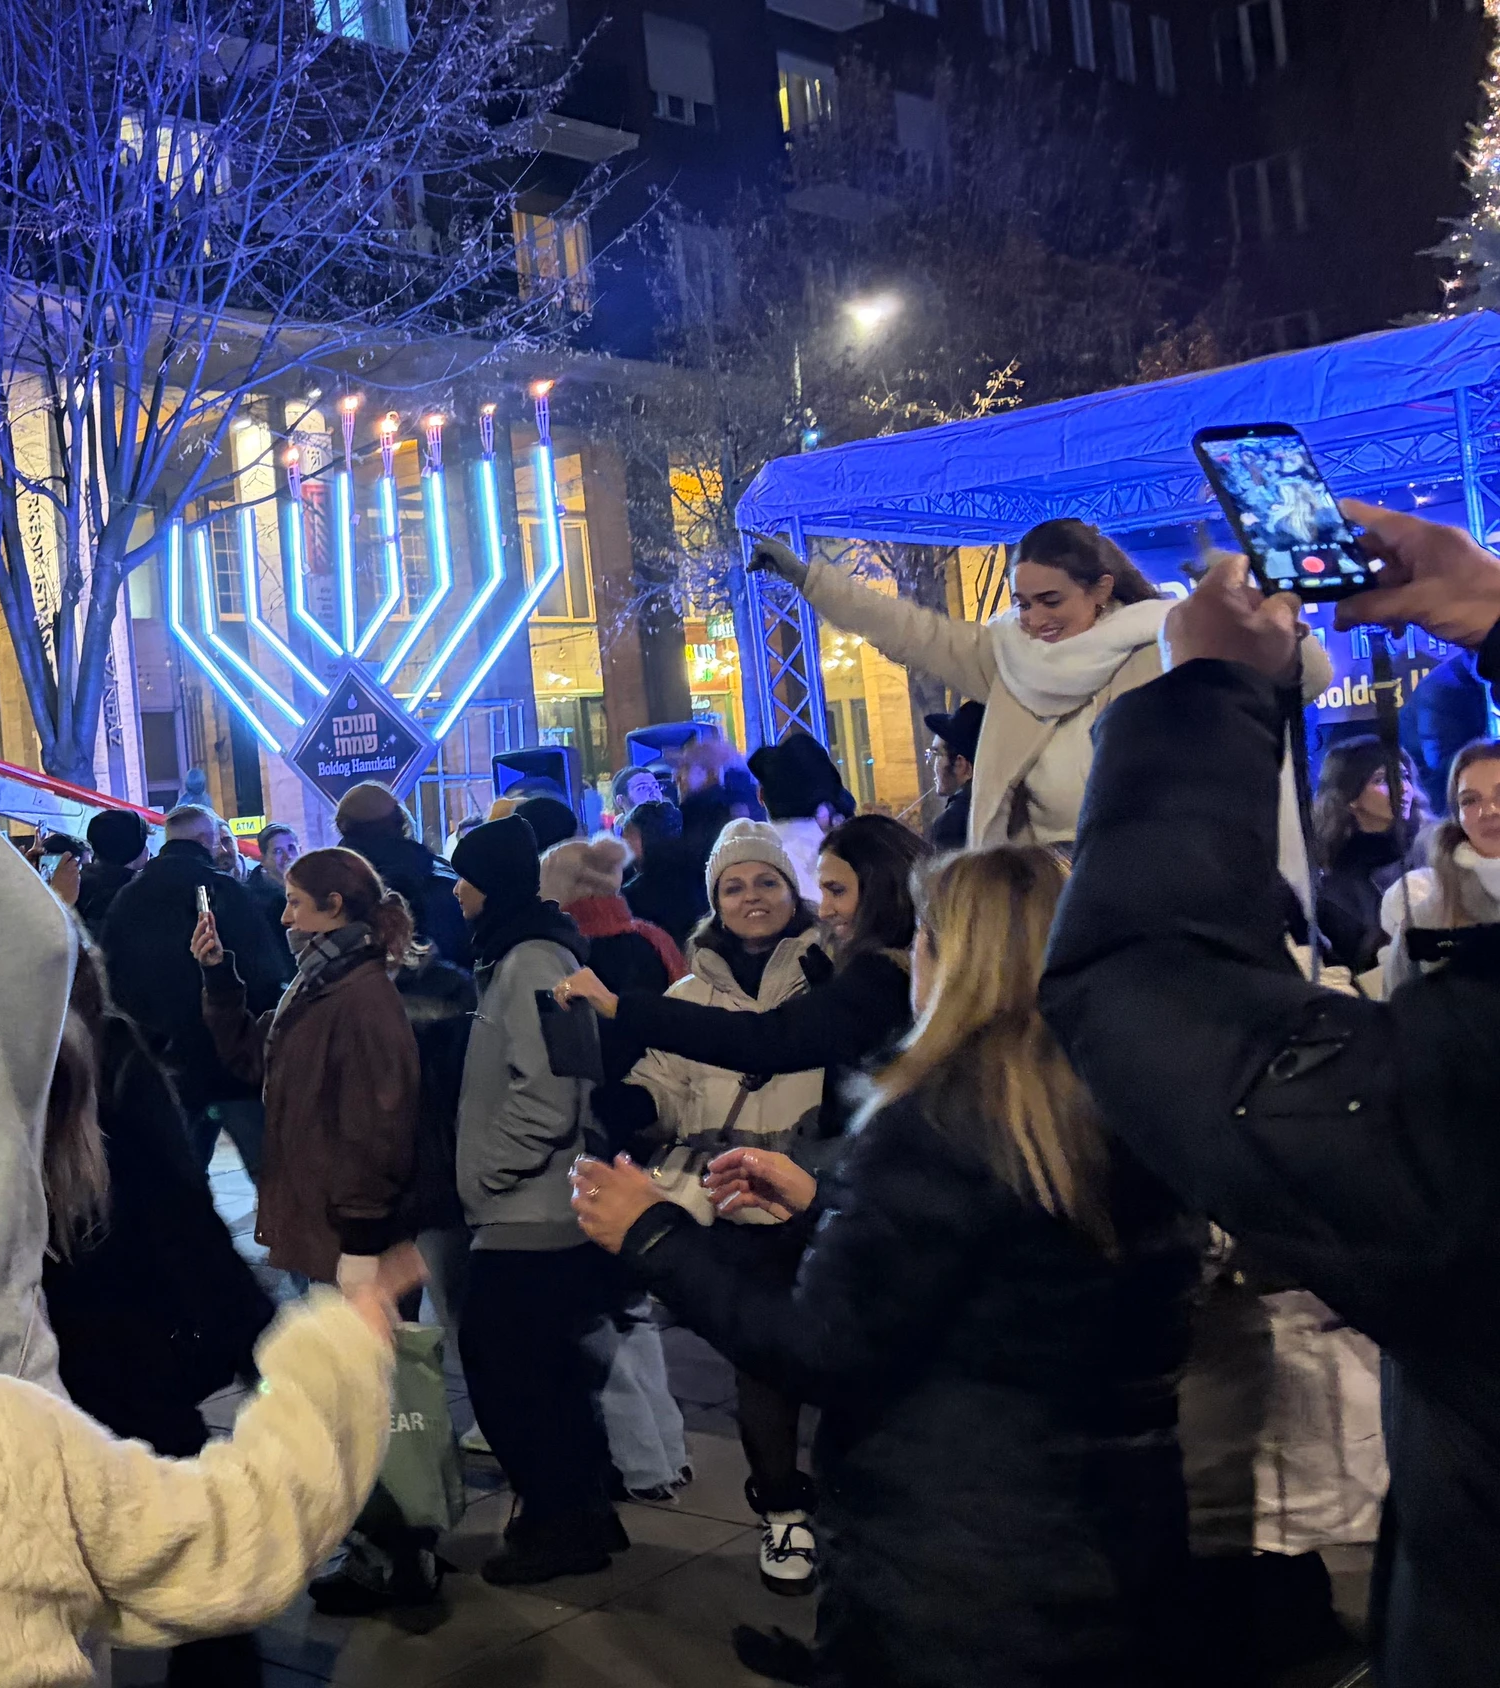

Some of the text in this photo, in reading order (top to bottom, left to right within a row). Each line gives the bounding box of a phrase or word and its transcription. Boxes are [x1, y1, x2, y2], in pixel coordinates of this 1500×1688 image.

[332, 713, 377, 736] חנוכה
[317, 755, 396, 777] Boldog Hanukát!
[236, 821, 255, 831] ATM
